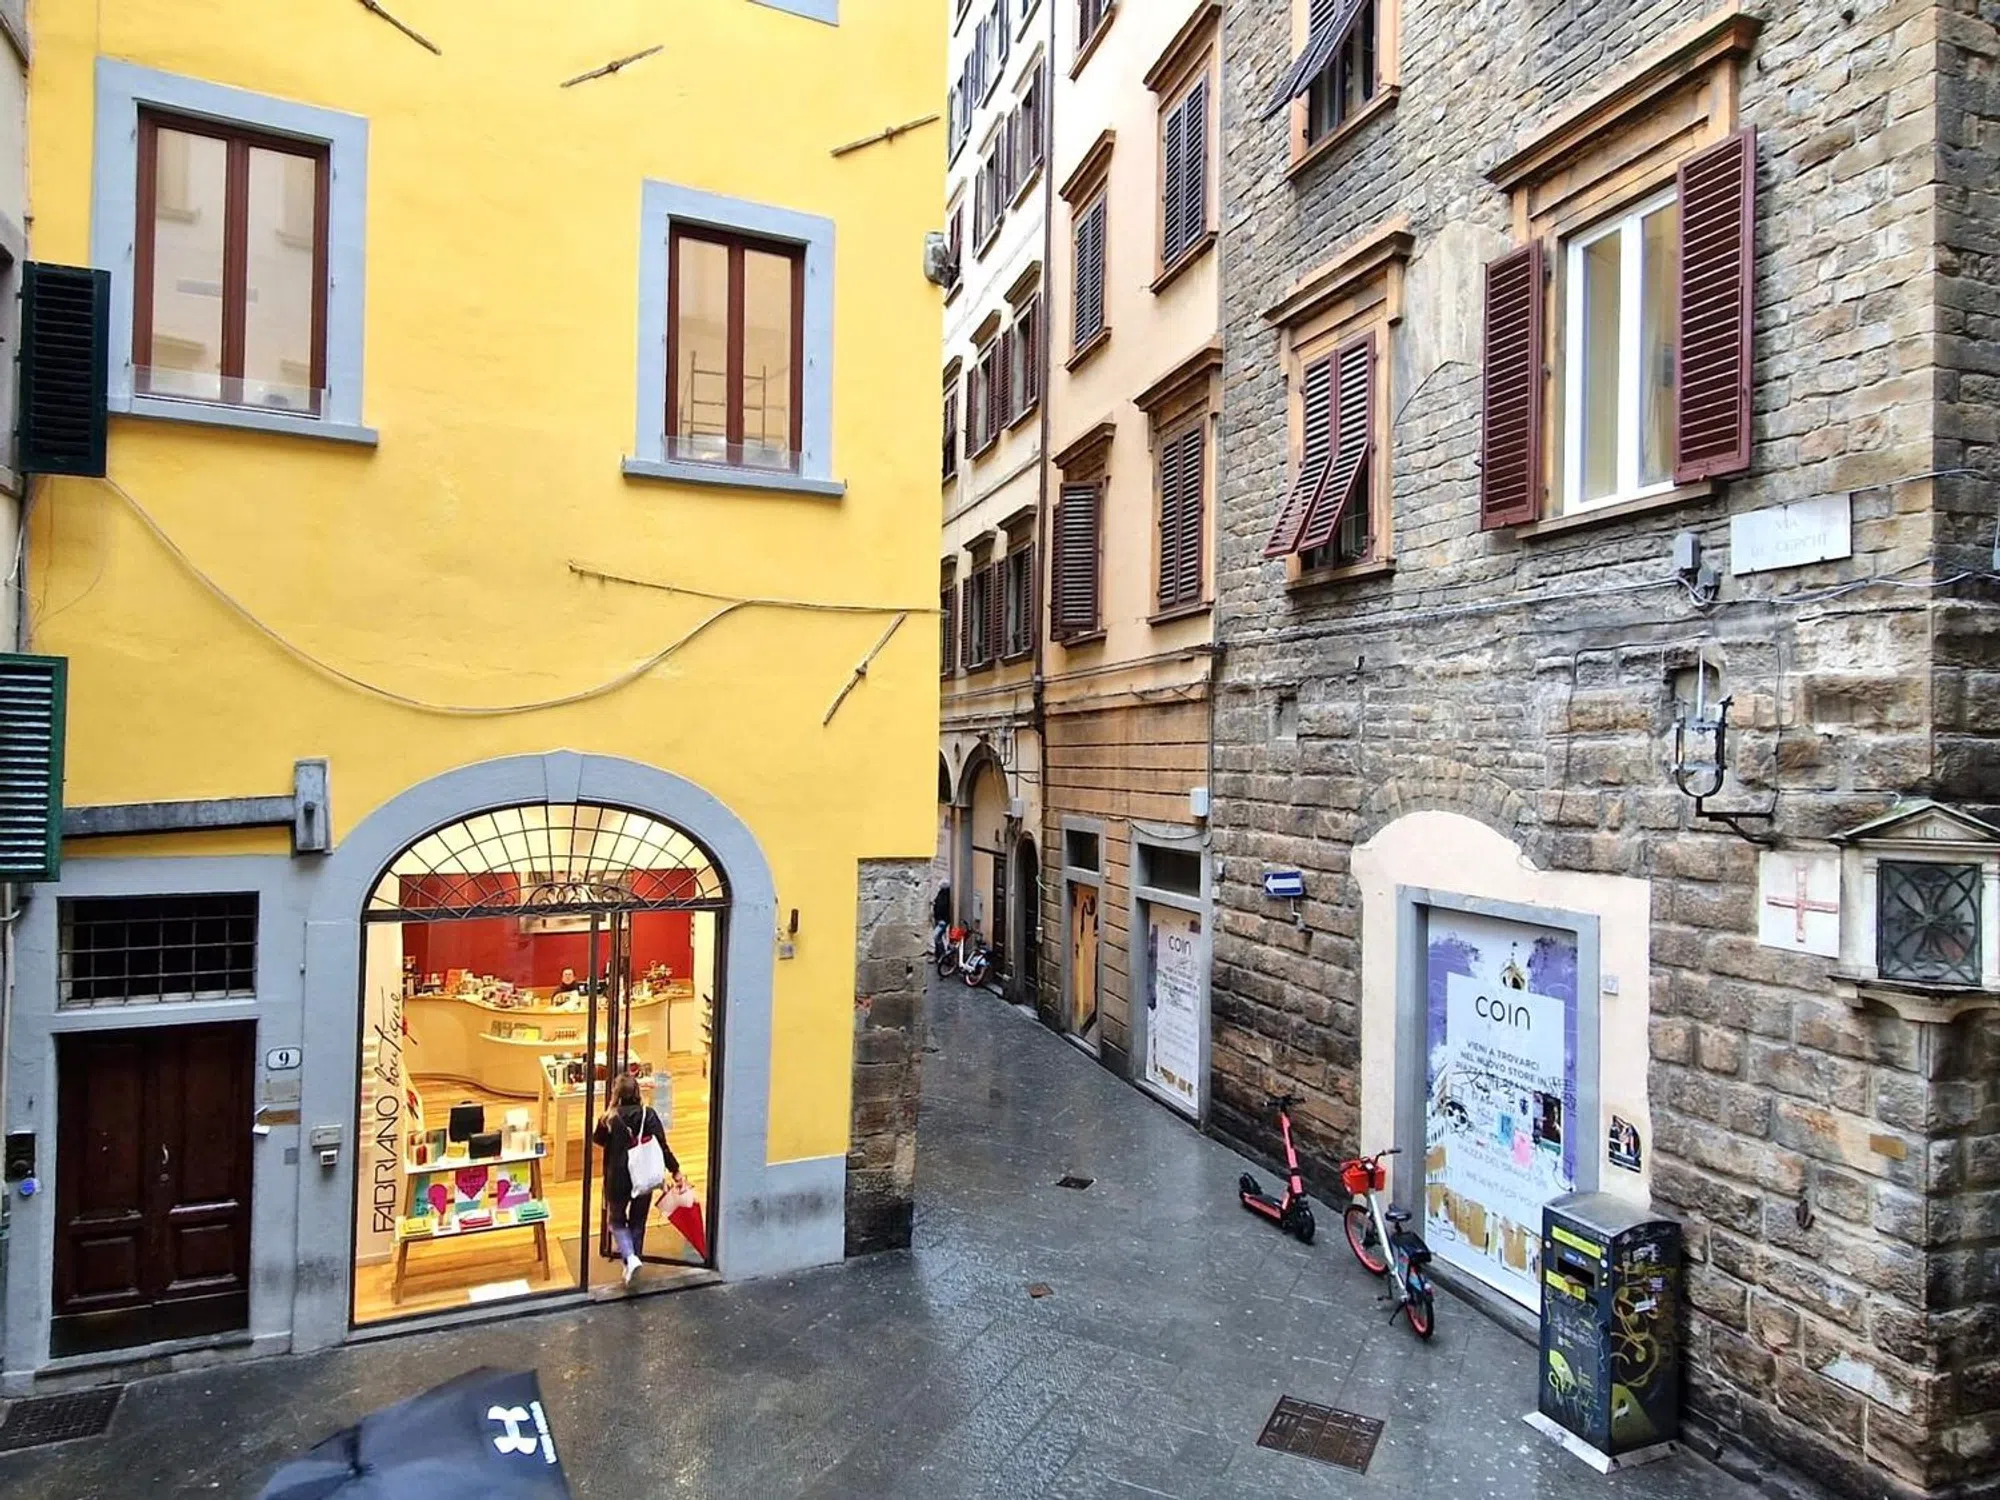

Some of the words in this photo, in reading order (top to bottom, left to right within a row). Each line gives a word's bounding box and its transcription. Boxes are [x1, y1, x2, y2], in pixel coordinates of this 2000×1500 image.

[279, 1051, 289, 1066] 9
[1498, 1050, 1540, 1071] TROVARCI
[1508, 1066, 1535, 1082] STORE
[373, 1095, 399, 1234] FABRIANO
